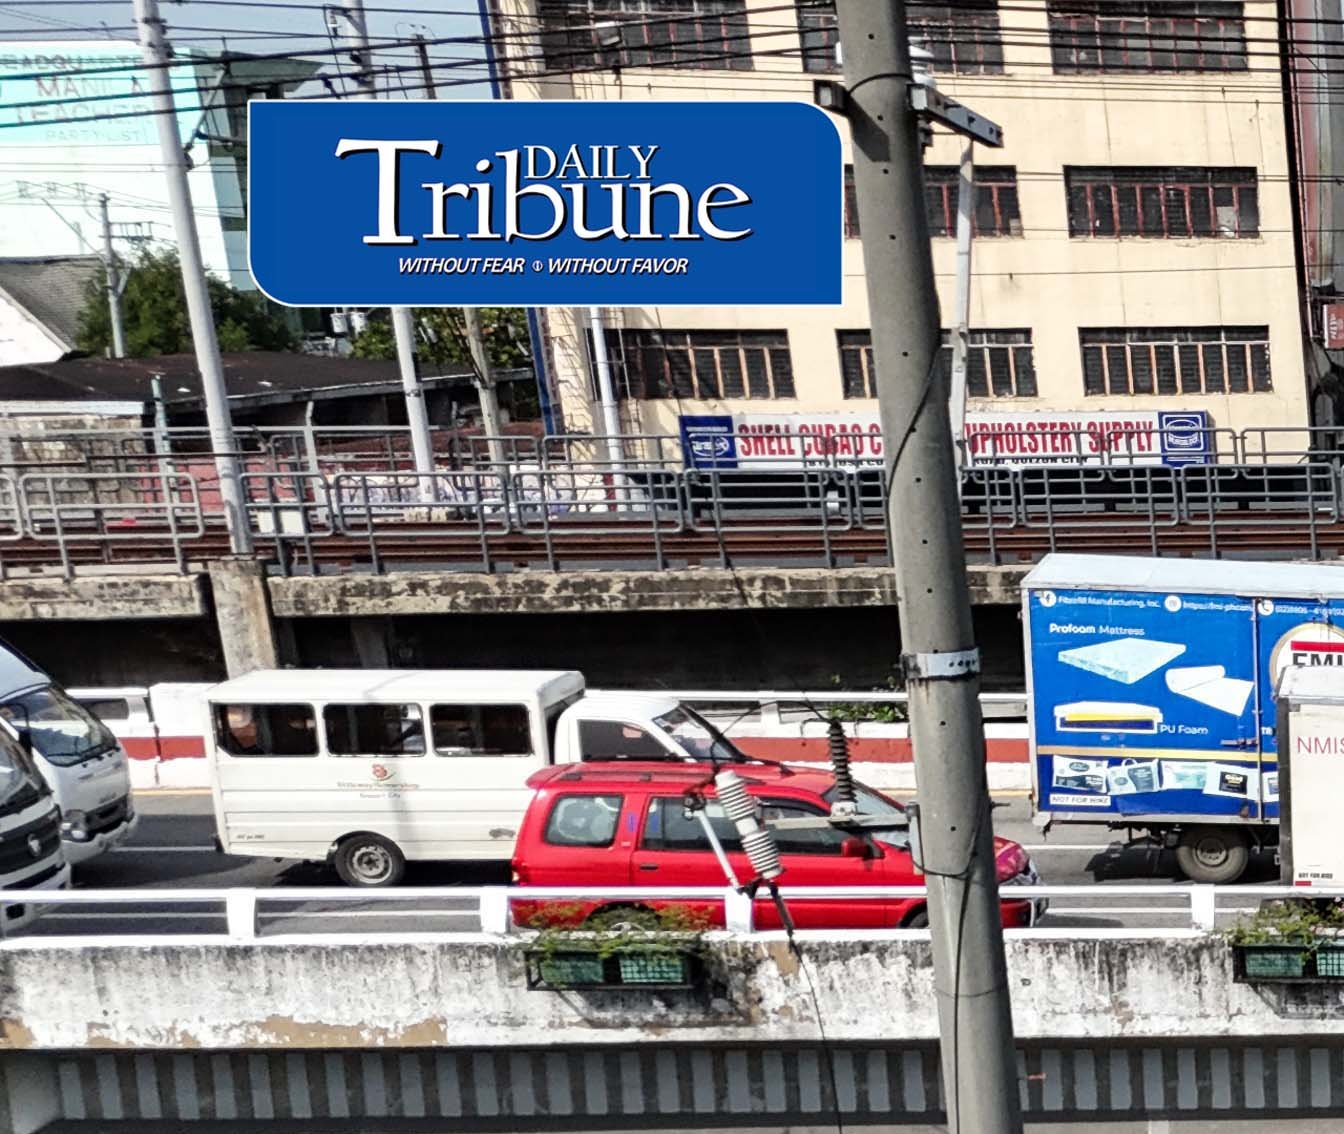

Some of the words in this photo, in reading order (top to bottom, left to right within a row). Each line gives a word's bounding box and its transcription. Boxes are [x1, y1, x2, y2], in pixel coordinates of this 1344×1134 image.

[738, 423, 795, 457] SHELL
[798, 423, 865, 457] CUBAO
[965, 421, 1082, 455] UPHOLSTERY
[1087, 421, 1154, 454] SUPPLY
[1049, 623, 1096, 634] Profoam
[1099, 625, 1146, 636] Mattress
[1159, 724, 1176, 734] PU
[1178, 724, 1209, 735] Foam
